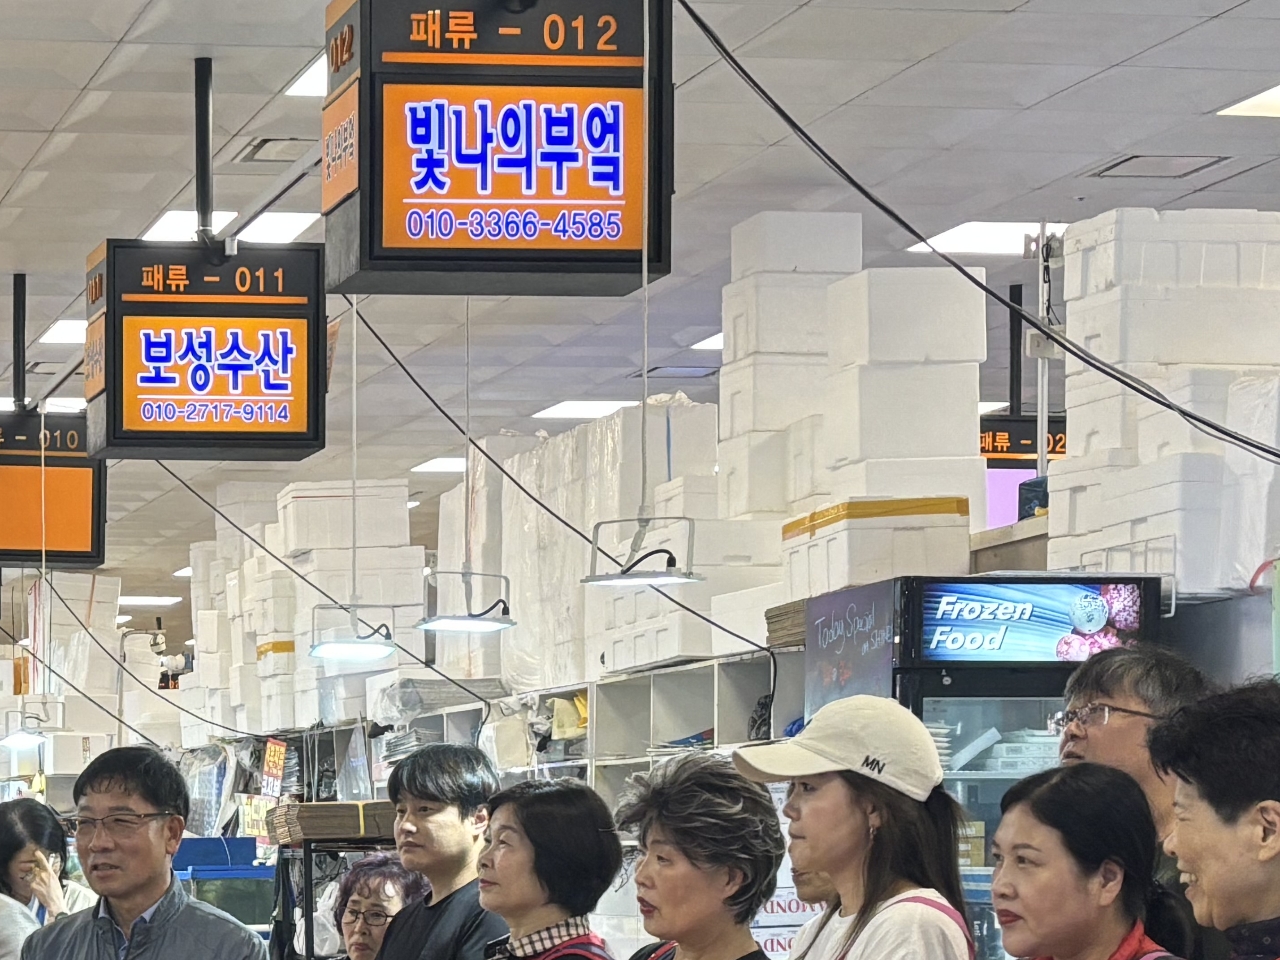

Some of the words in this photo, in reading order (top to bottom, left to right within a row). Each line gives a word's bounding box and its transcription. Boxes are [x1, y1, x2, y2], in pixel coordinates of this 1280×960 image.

[410, 10, 477, 49] 패류
[543, 14, 617, 51] 012
[329, 24, 354, 73] 012
[405, 99, 624, 195] 빛나의부엌
[406, 209, 623, 240] 010-3366-4585
[141, 264, 189, 292] 패류
[235, 266, 284, 293] 011
[137, 327, 297, 394] 보성수산
[142, 402, 290, 422] 010-2717-9114
[39, 429, 78, 448] 010
[935, 595, 1034, 620] Frozen
[929, 625, 1008, 651] Food
[861, 755, 887, 775] MN
